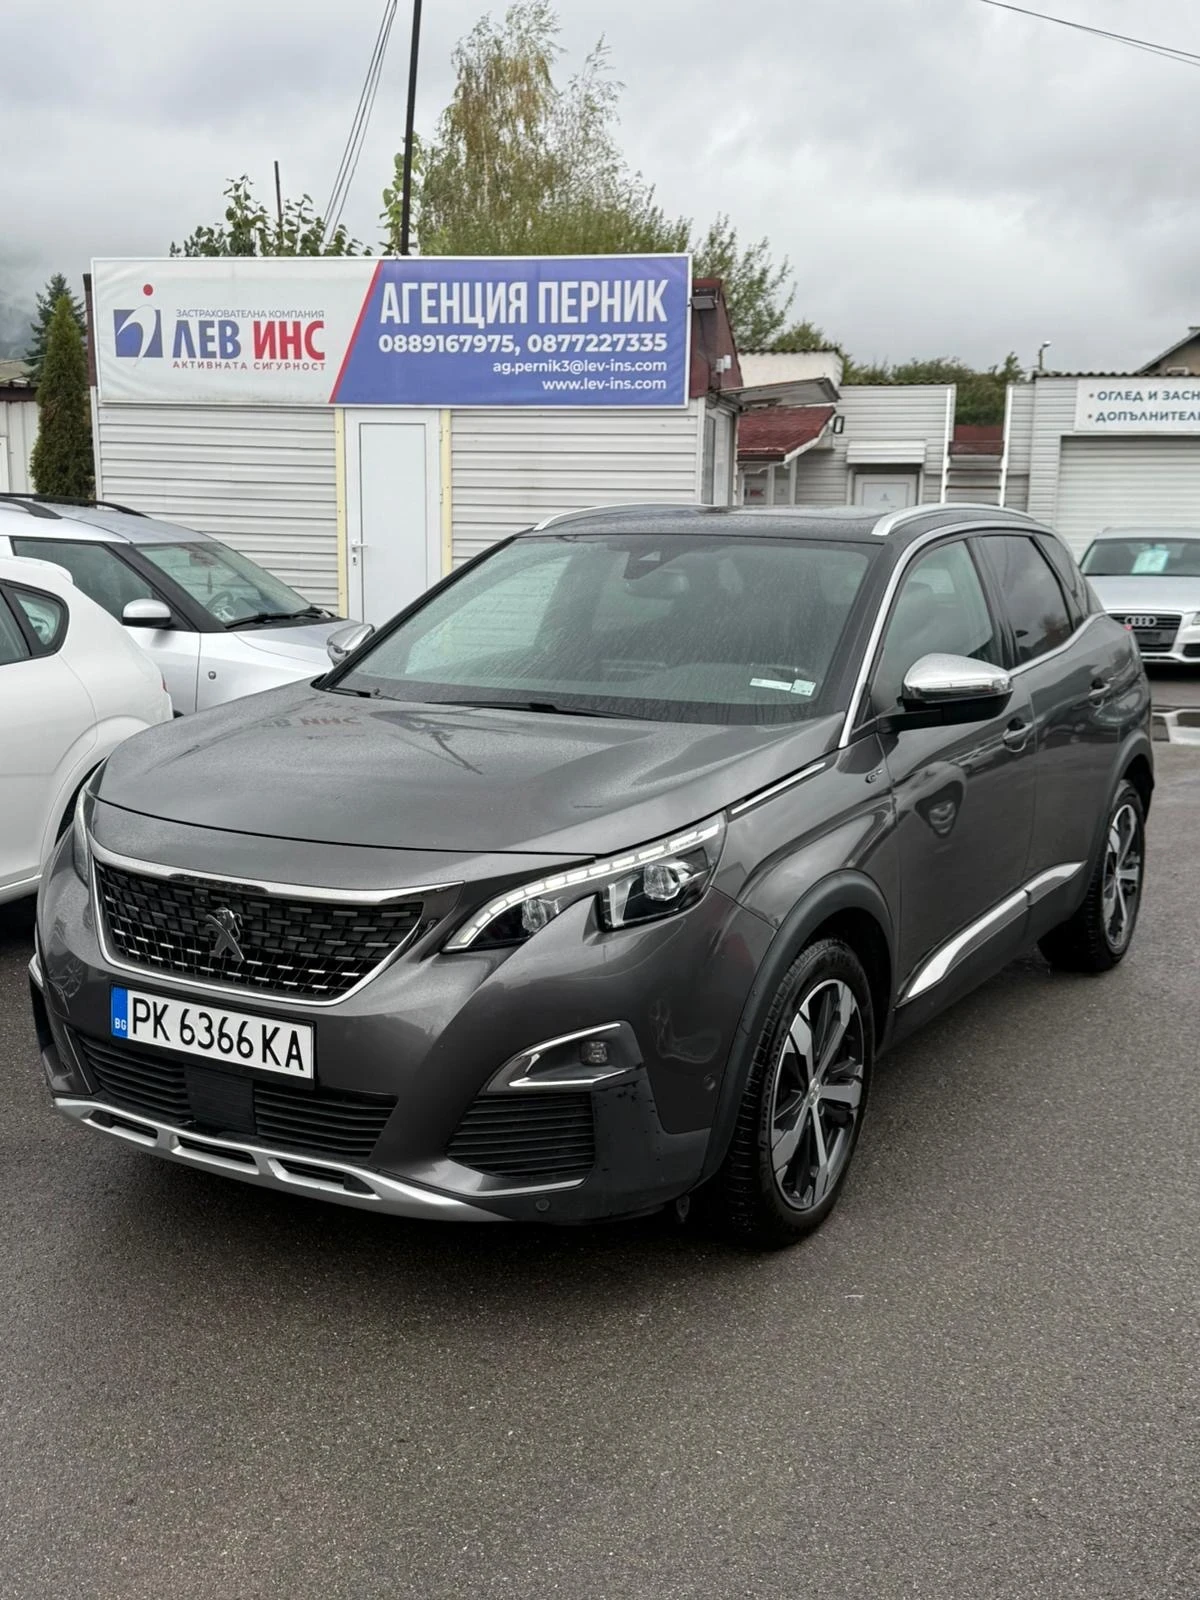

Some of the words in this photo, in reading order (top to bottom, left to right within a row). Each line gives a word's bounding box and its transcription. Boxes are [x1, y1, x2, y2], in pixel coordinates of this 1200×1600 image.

[379, 282, 528, 329] АГЕНЦИЯ
[538, 279, 669, 324] ПЕРНИК
[175, 308, 267, 319] ЗАСТРАХОВАТЕЛНА
[267, 309, 325, 319] КОМПАНИЯ
[172, 319, 242, 359] ЛЕВ
[253, 320, 326, 361] ИНС
[378, 334, 521, 356] 0889167975,
[527, 333, 668, 353] 0877227335
[172, 361, 248, 370] АКТИВНАТА
[253, 361, 326, 371] СИГУРНОСТ
[492, 359, 667, 375] ag.pernik3@lev-ins.com
[541, 378, 667, 391] www.lev-ins.com
[1097, 391, 1144, 402] ОГЛЕД
[1148, 391, 1158, 401] И
[114, 1018, 127, 1031] BG
[179, 1008, 254, 1059] 6366
